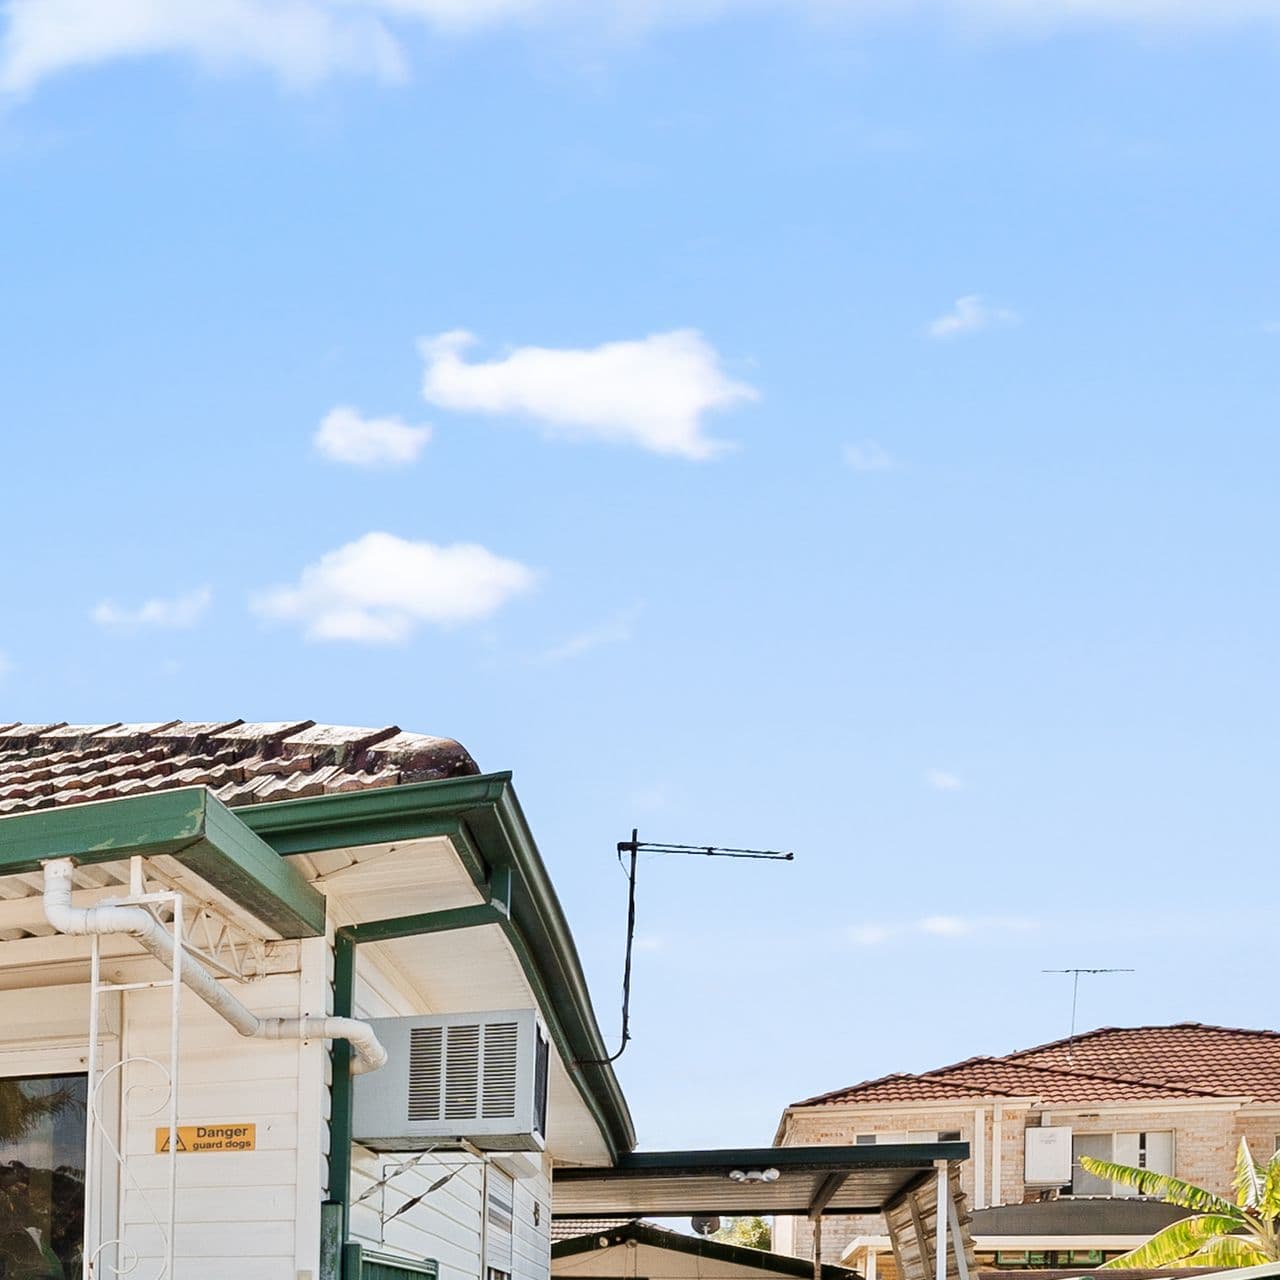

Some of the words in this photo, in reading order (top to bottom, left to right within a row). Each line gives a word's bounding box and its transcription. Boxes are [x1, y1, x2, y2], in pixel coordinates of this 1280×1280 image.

[197, 1127, 248, 1139] Danger
[193, 1141, 223, 1151] guard
[225, 1140, 251, 1150] dogs
